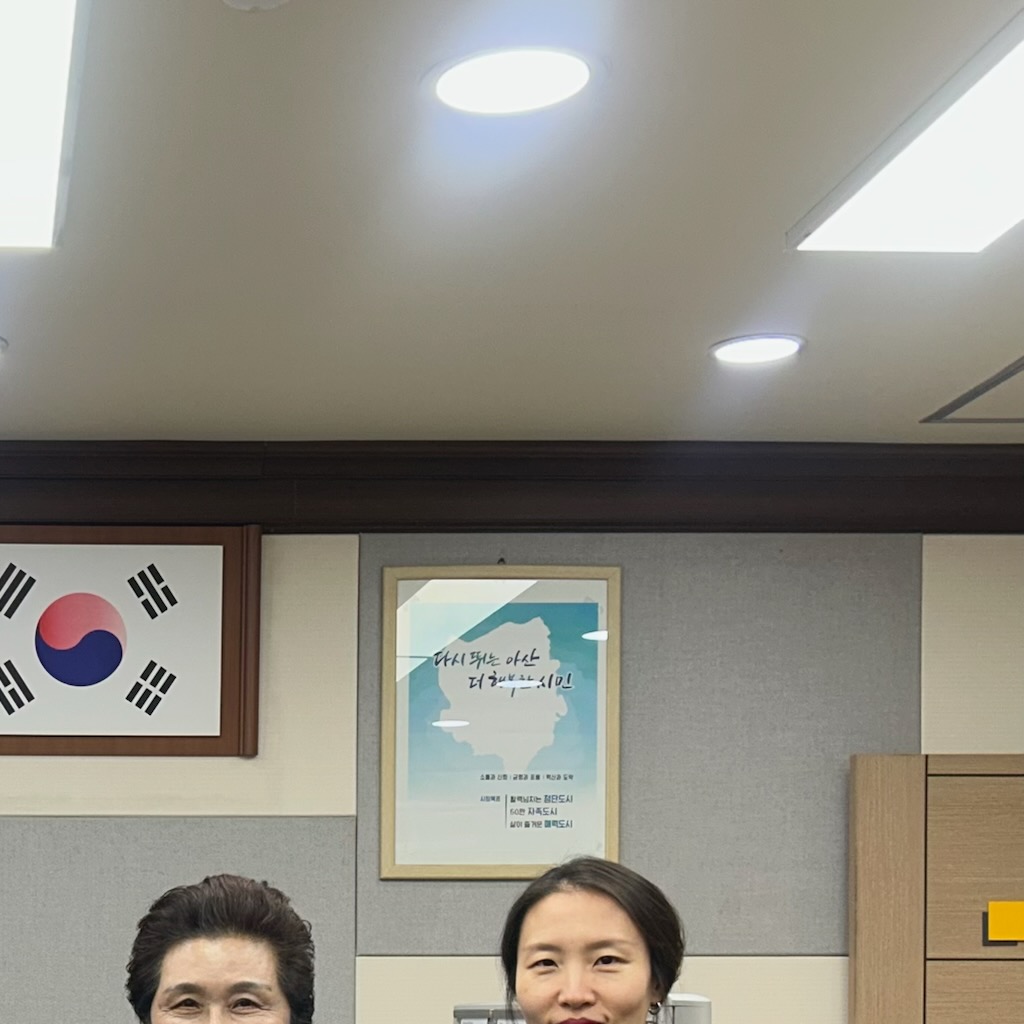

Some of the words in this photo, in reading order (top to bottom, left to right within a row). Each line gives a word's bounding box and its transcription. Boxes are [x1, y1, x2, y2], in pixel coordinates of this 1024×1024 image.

[433, 650, 466, 668] 다시
[469, 650, 501, 668] 뛰는
[505, 648, 541, 668] 아산
[468, 673, 485, 689] 더
[537, 673, 573, 689] 시민
[544, 795, 573, 803] 첨단도시
[528, 807, 558, 815] 자족도시
[544, 820, 573, 828] 매력도시
